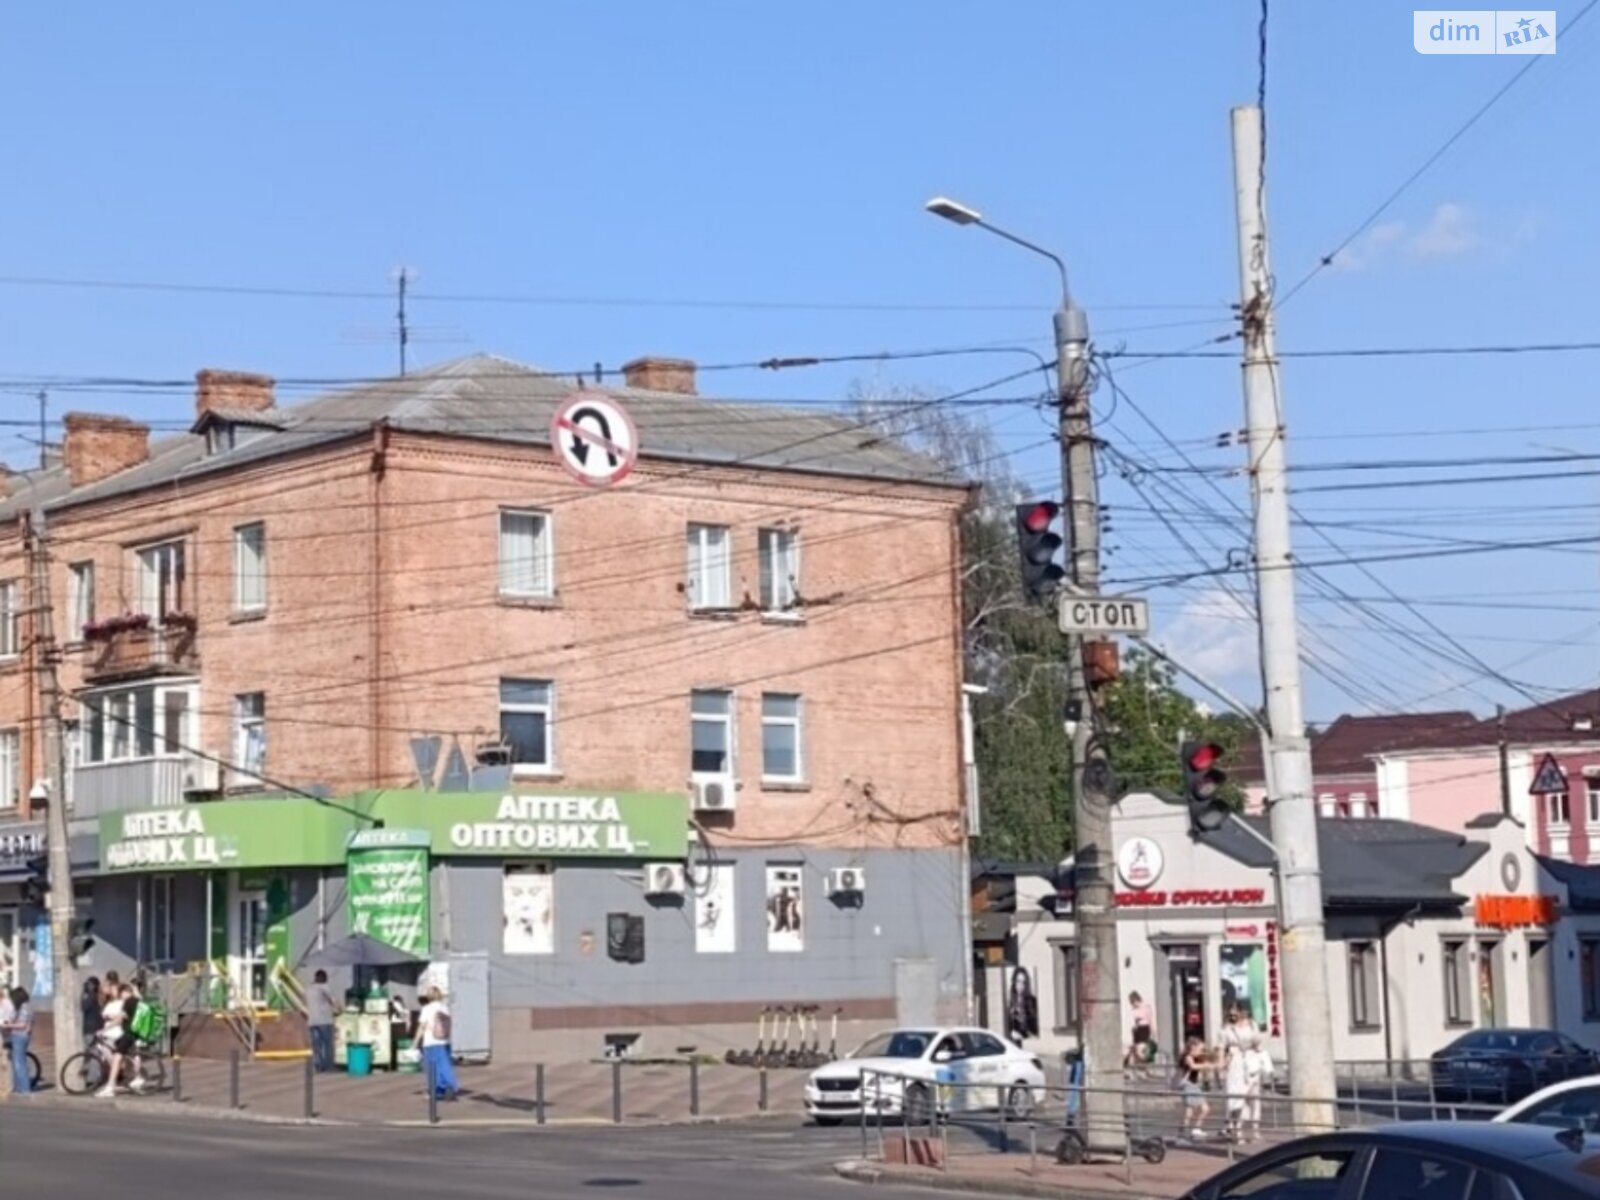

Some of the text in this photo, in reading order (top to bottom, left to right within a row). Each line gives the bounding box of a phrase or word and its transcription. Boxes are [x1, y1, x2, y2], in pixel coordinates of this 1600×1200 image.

[1073, 603, 1136, 626] СТОП
[497, 795, 621, 820] АПТЕКА
[451, 822, 599, 849] ОПТОВИХ
